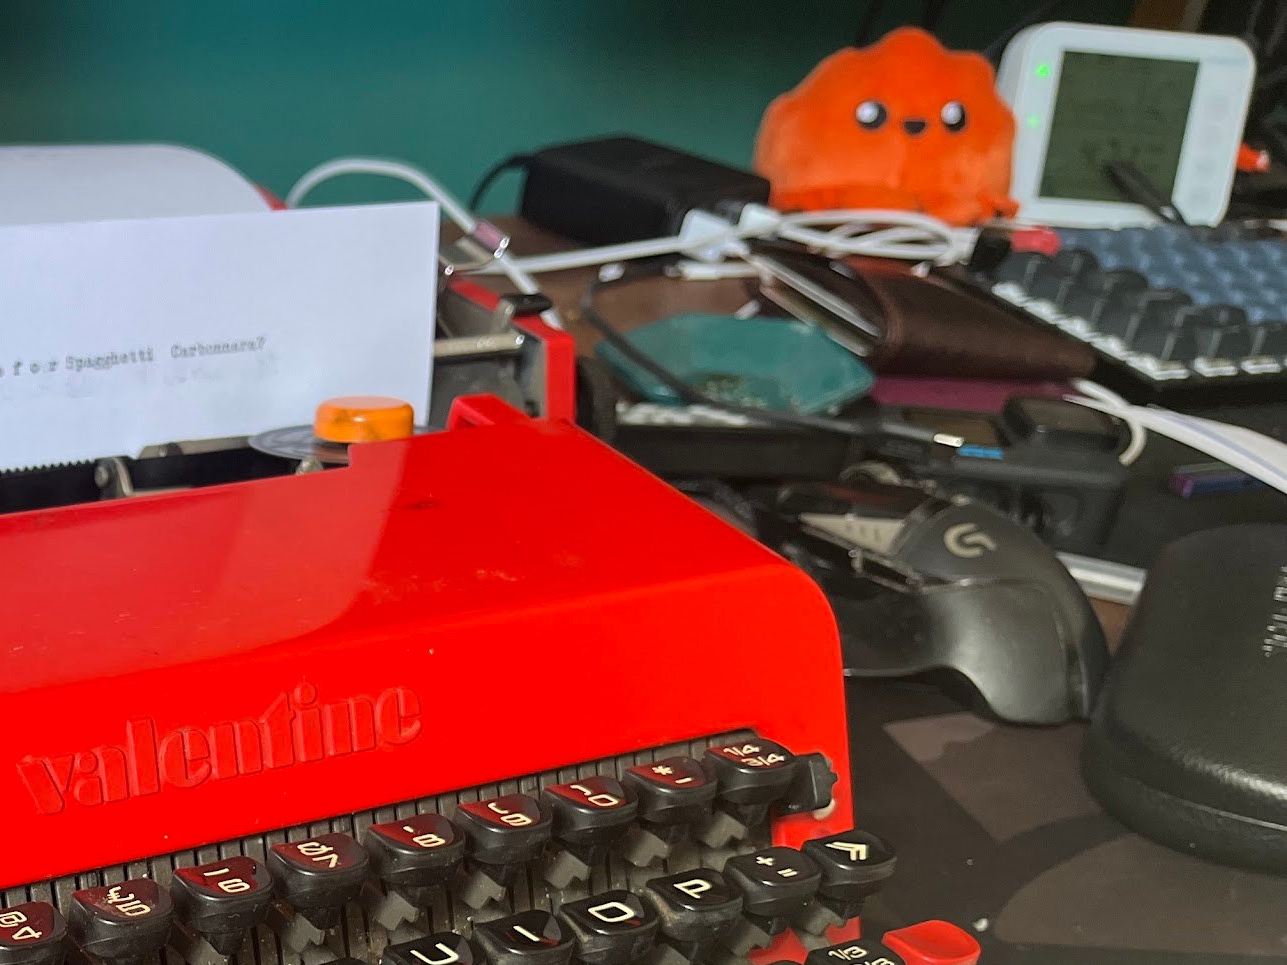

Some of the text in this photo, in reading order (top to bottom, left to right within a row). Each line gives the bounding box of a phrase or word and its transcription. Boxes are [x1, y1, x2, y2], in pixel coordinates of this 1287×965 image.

[16, 681, 422, 815] valentine
[501, 813, 532, 827] 9
[413, 833, 446, 848] 8
[313, 852, 338, 868] 7
[218, 878, 251, 893] 6
[674, 878, 712, 899] P
[116, 900, 151, 916] 5
[588, 901, 635, 923] O
[12, 926, 42, 941] 4
[513, 925, 540, 942] I
[410, 943, 459, 965] U
